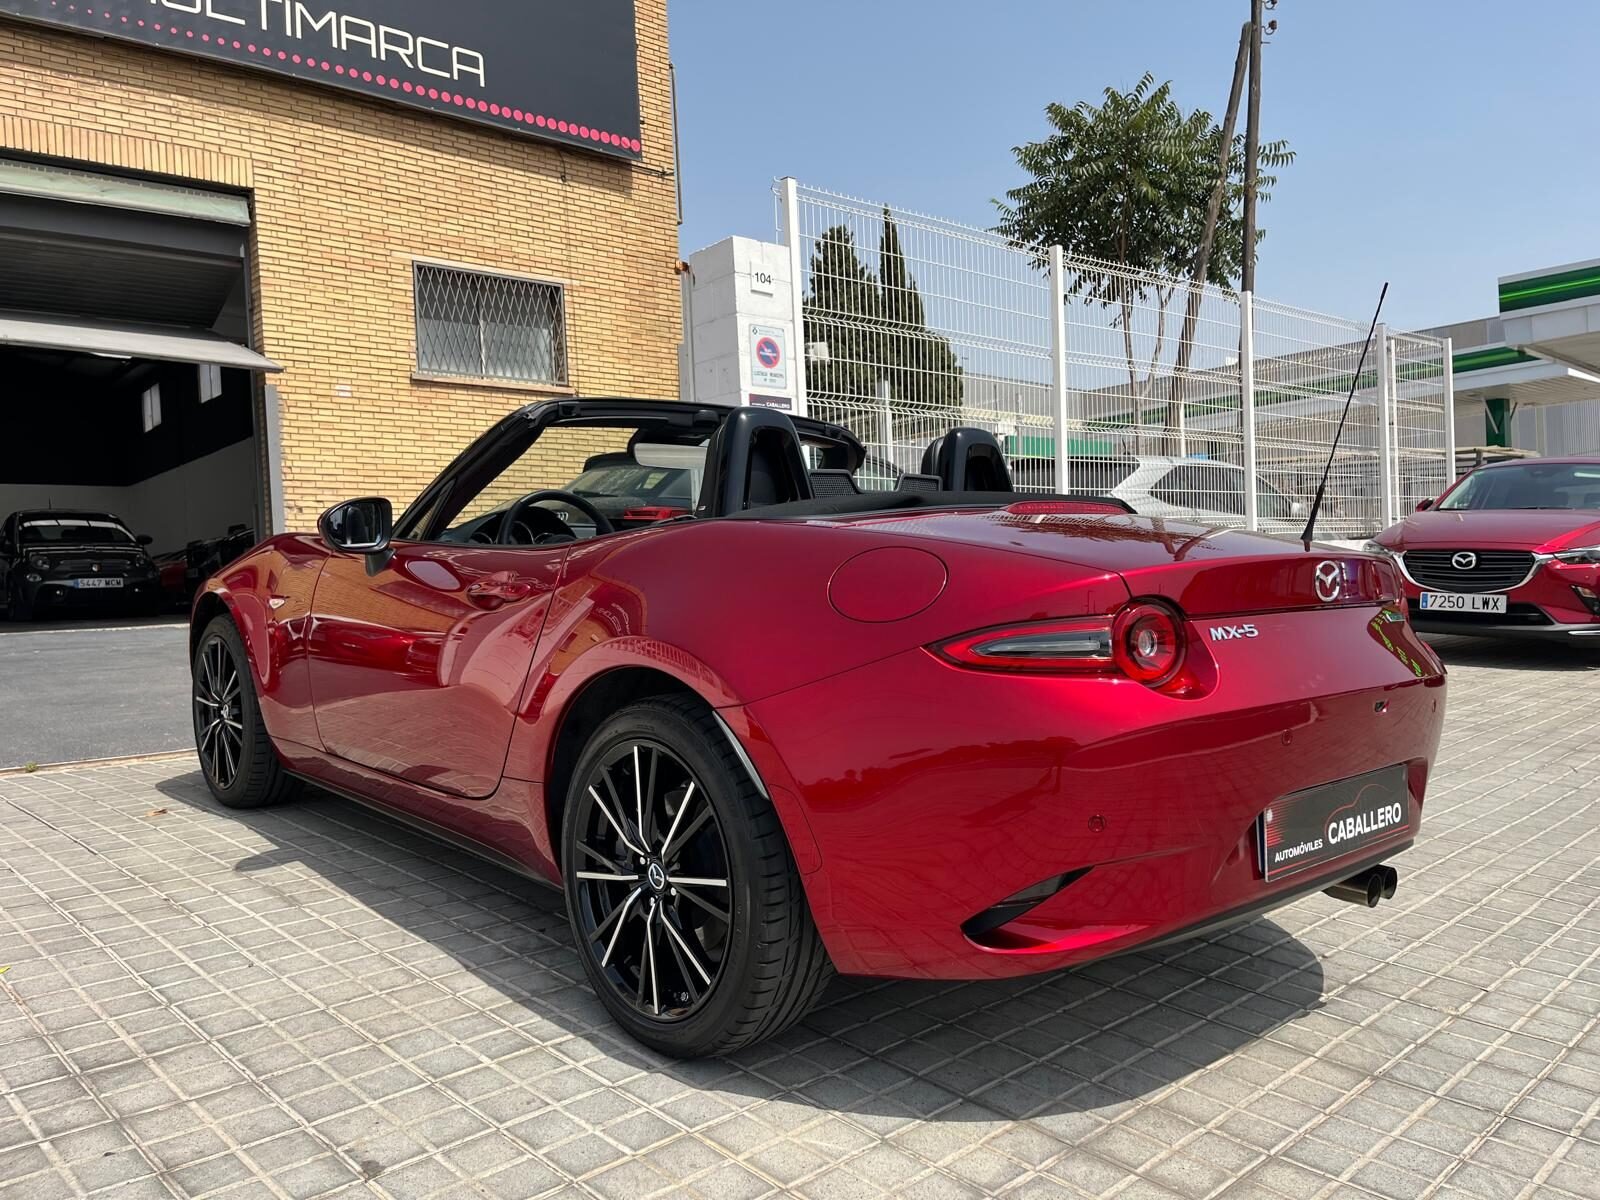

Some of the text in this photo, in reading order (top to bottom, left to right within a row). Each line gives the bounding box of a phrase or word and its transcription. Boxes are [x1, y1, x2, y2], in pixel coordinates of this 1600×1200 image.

[754, 272, 772, 285] 104
[1429, 594, 1500, 611] 7250 LWX
[1209, 623, 1259, 641] MX-5
[1274, 802, 1402, 863] AUTOMÓVILES CABALLERO
